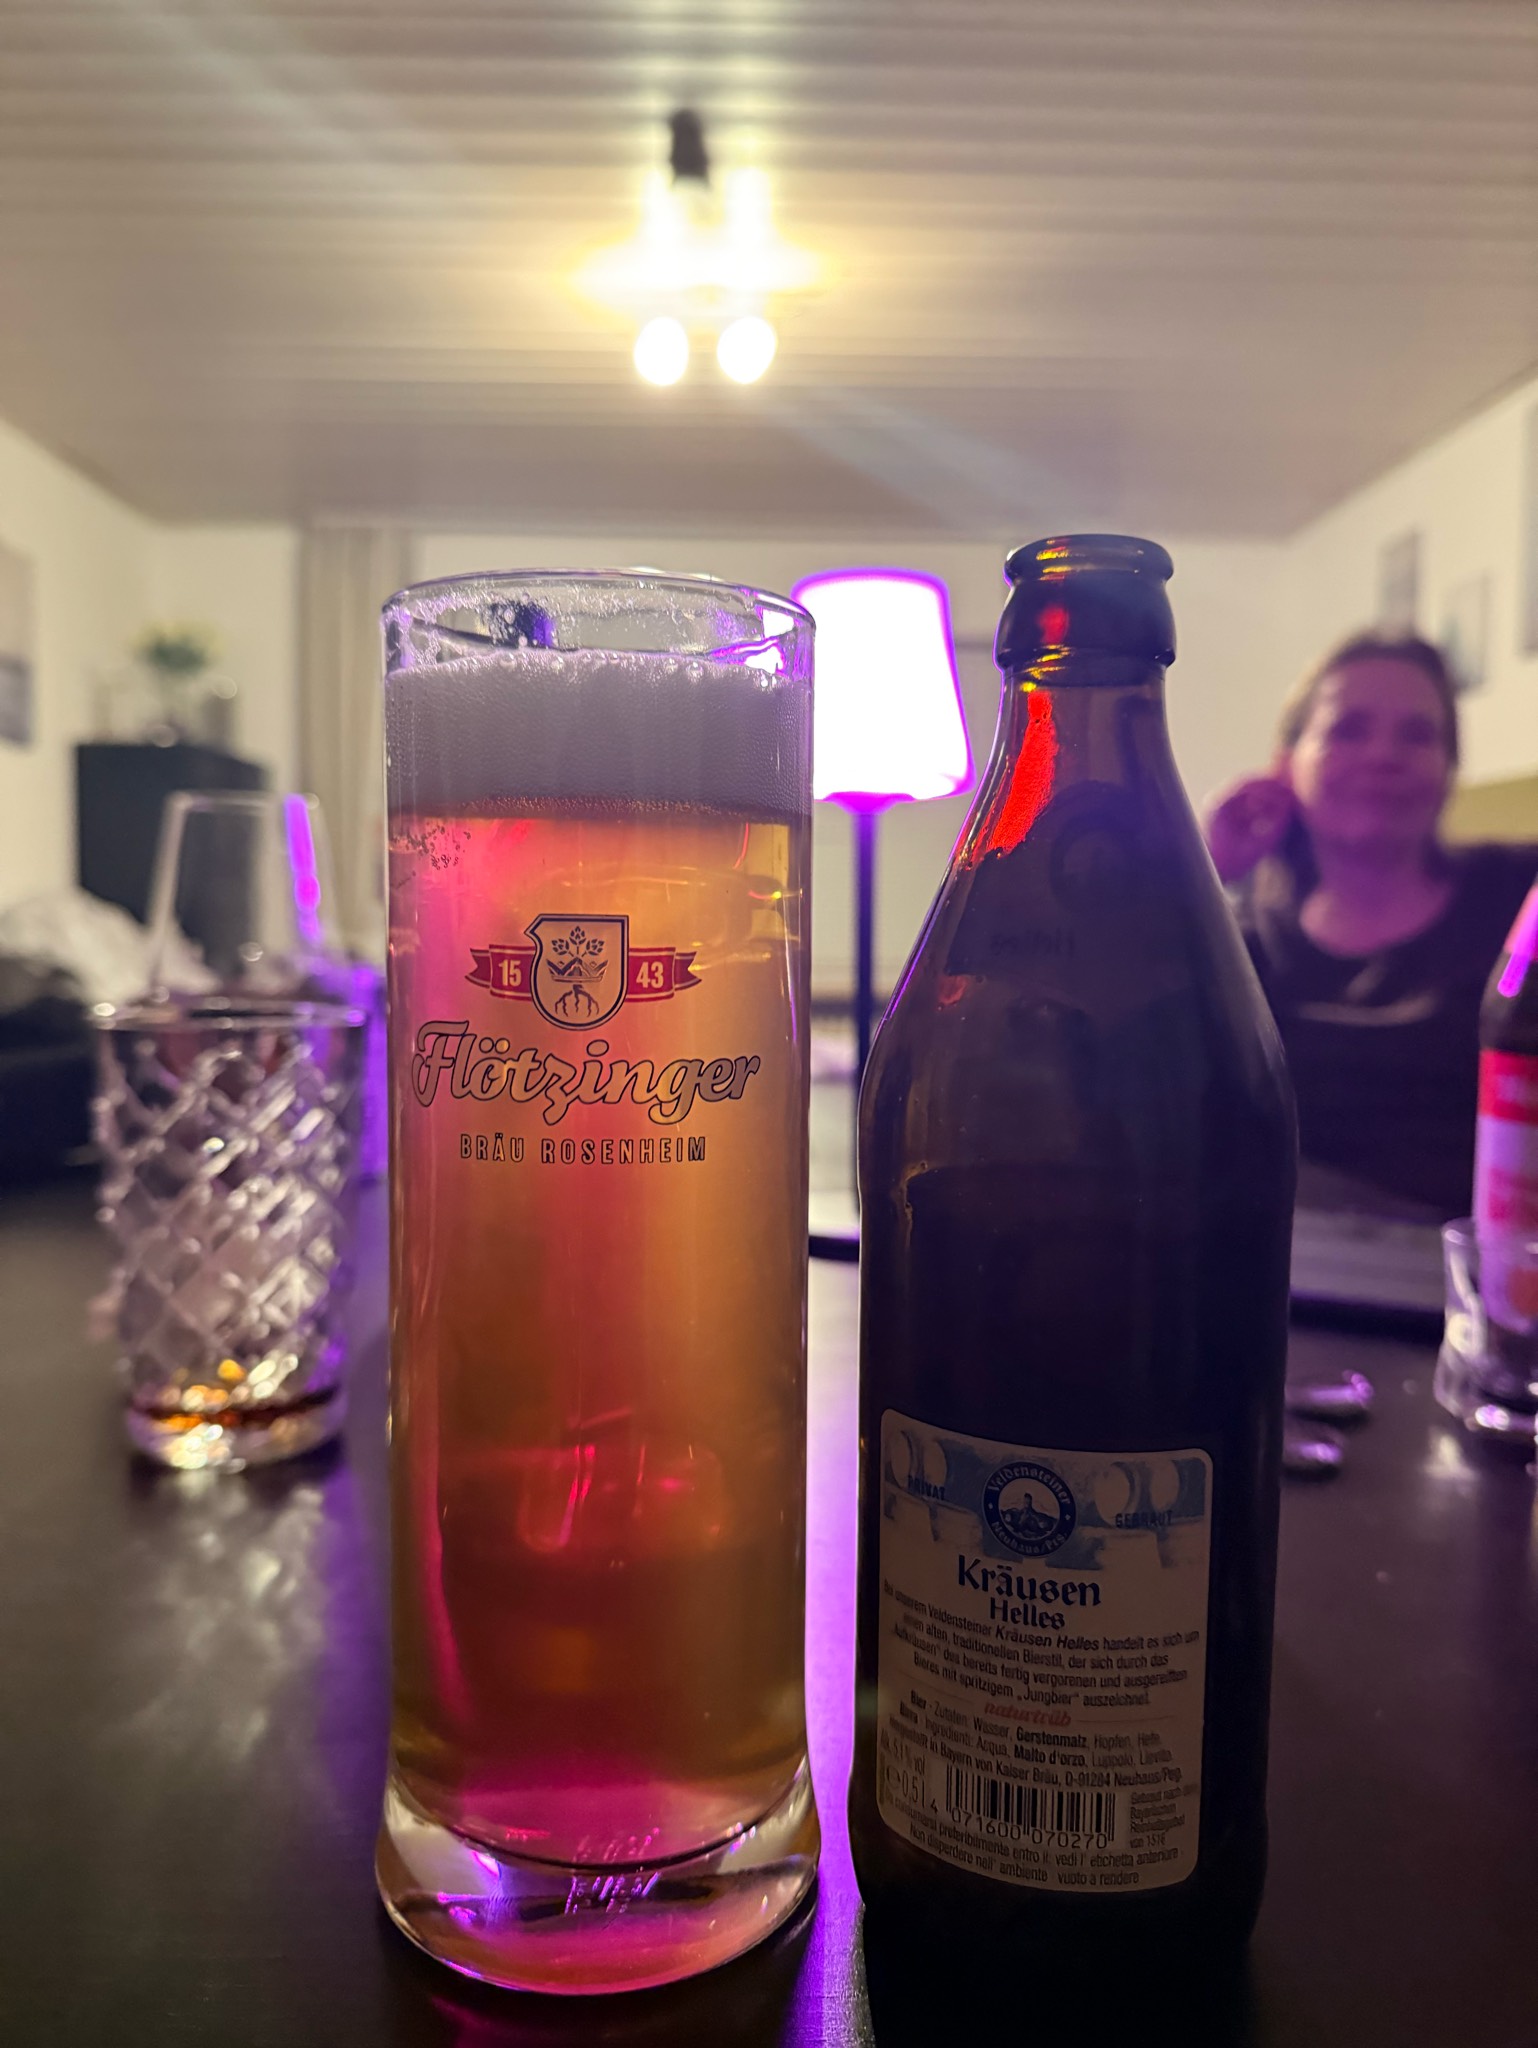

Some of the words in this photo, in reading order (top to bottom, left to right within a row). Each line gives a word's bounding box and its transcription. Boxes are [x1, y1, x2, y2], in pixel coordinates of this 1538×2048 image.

[498, 959, 521, 987] 15
[636, 963, 664, 989] 43
[412, 1019, 760, 1126] Flötzinger
[460, 1133, 524, 1162] BRÄU
[541, 1136, 706, 1164] ROSENHEIM
[958, 1555, 1101, 1607] Kräusen
[928, 1603, 992, 1637] Veldensteiner
[995, 1625, 1052, 1648] Kräusen
[1056, 1636, 1100, 1651] Helles
[1103, 1636, 1144, 1651] handelt
[990, 1597, 1065, 1630] Helles
[953, 1632, 1019, 1662] traditionellen
[1068, 1654, 1086, 1669] der
[1090, 1656, 1113, 1670] sich
[1116, 1655, 1148, 1669] durch
[1150, 1653, 1169, 1667] das
[942, 1667, 957, 1682] mit
[959, 1674, 1014, 1697] spritzigem
[963, 1653, 998, 1676] bereits
[1001, 1662, 1030, 1685] fertig
[1033, 1672, 1097, 1688] vergorenen
[1100, 1674, 1121, 1688] und
[940, 1741, 972, 1767] Bayern
[975, 1757, 993, 1771] von
[996, 1759, 1030, 1781] Kaiser
[1014, 1744, 1046, 1763] Malto
[930, 1798, 938, 1815] 4
[951, 1807, 1021, 1841] 071600
[1031, 1828, 1107, 1849] 070270
[1055, 1851, 1077, 1866] vedi
